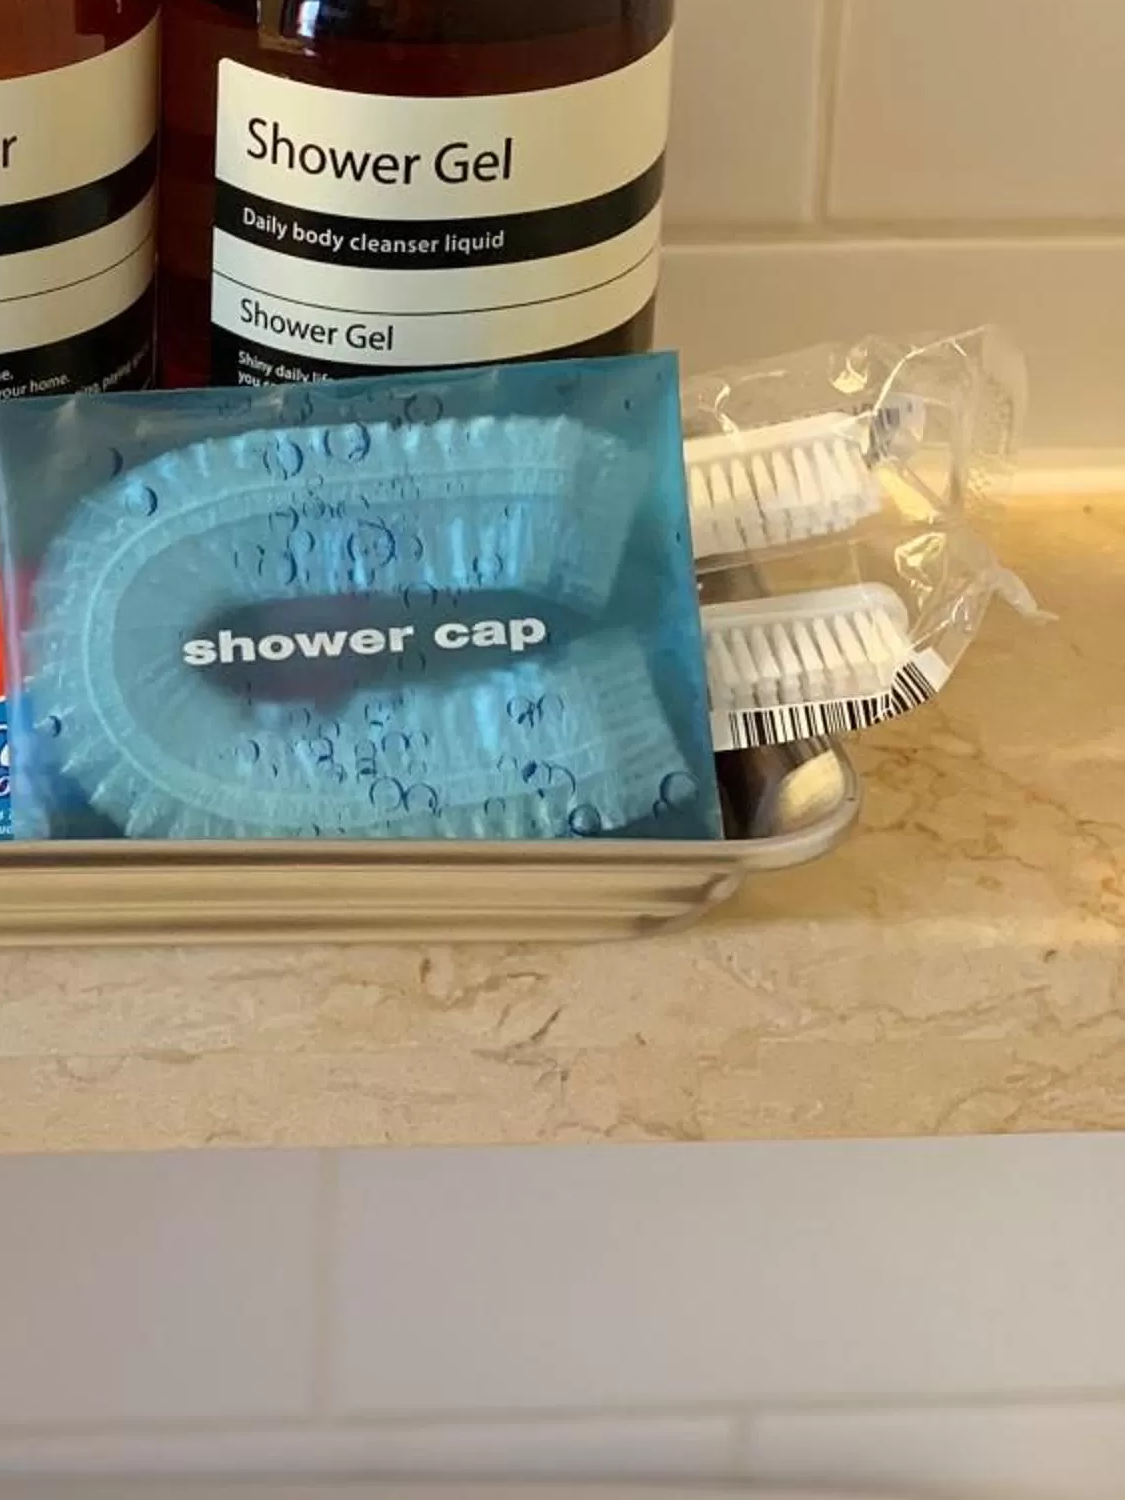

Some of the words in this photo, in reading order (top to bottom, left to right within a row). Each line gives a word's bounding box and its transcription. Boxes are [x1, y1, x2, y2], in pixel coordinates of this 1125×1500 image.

[246, 116, 421, 185] Shower
[433, 136, 513, 184] Gel
[242, 206, 287, 240] Daily
[292, 220, 344, 253] body
[349, 231, 440, 254] cleanser
[444, 229, 505, 256] liquid
[240, 298, 338, 346] Shower
[345, 324, 394, 351] Gel
[29, 373, 70, 393] home.
[238, 349, 274, 377] Shiny
[238, 370, 260, 388] you
[182, 622, 415, 668] shower
[433, 614, 548, 655] cap
